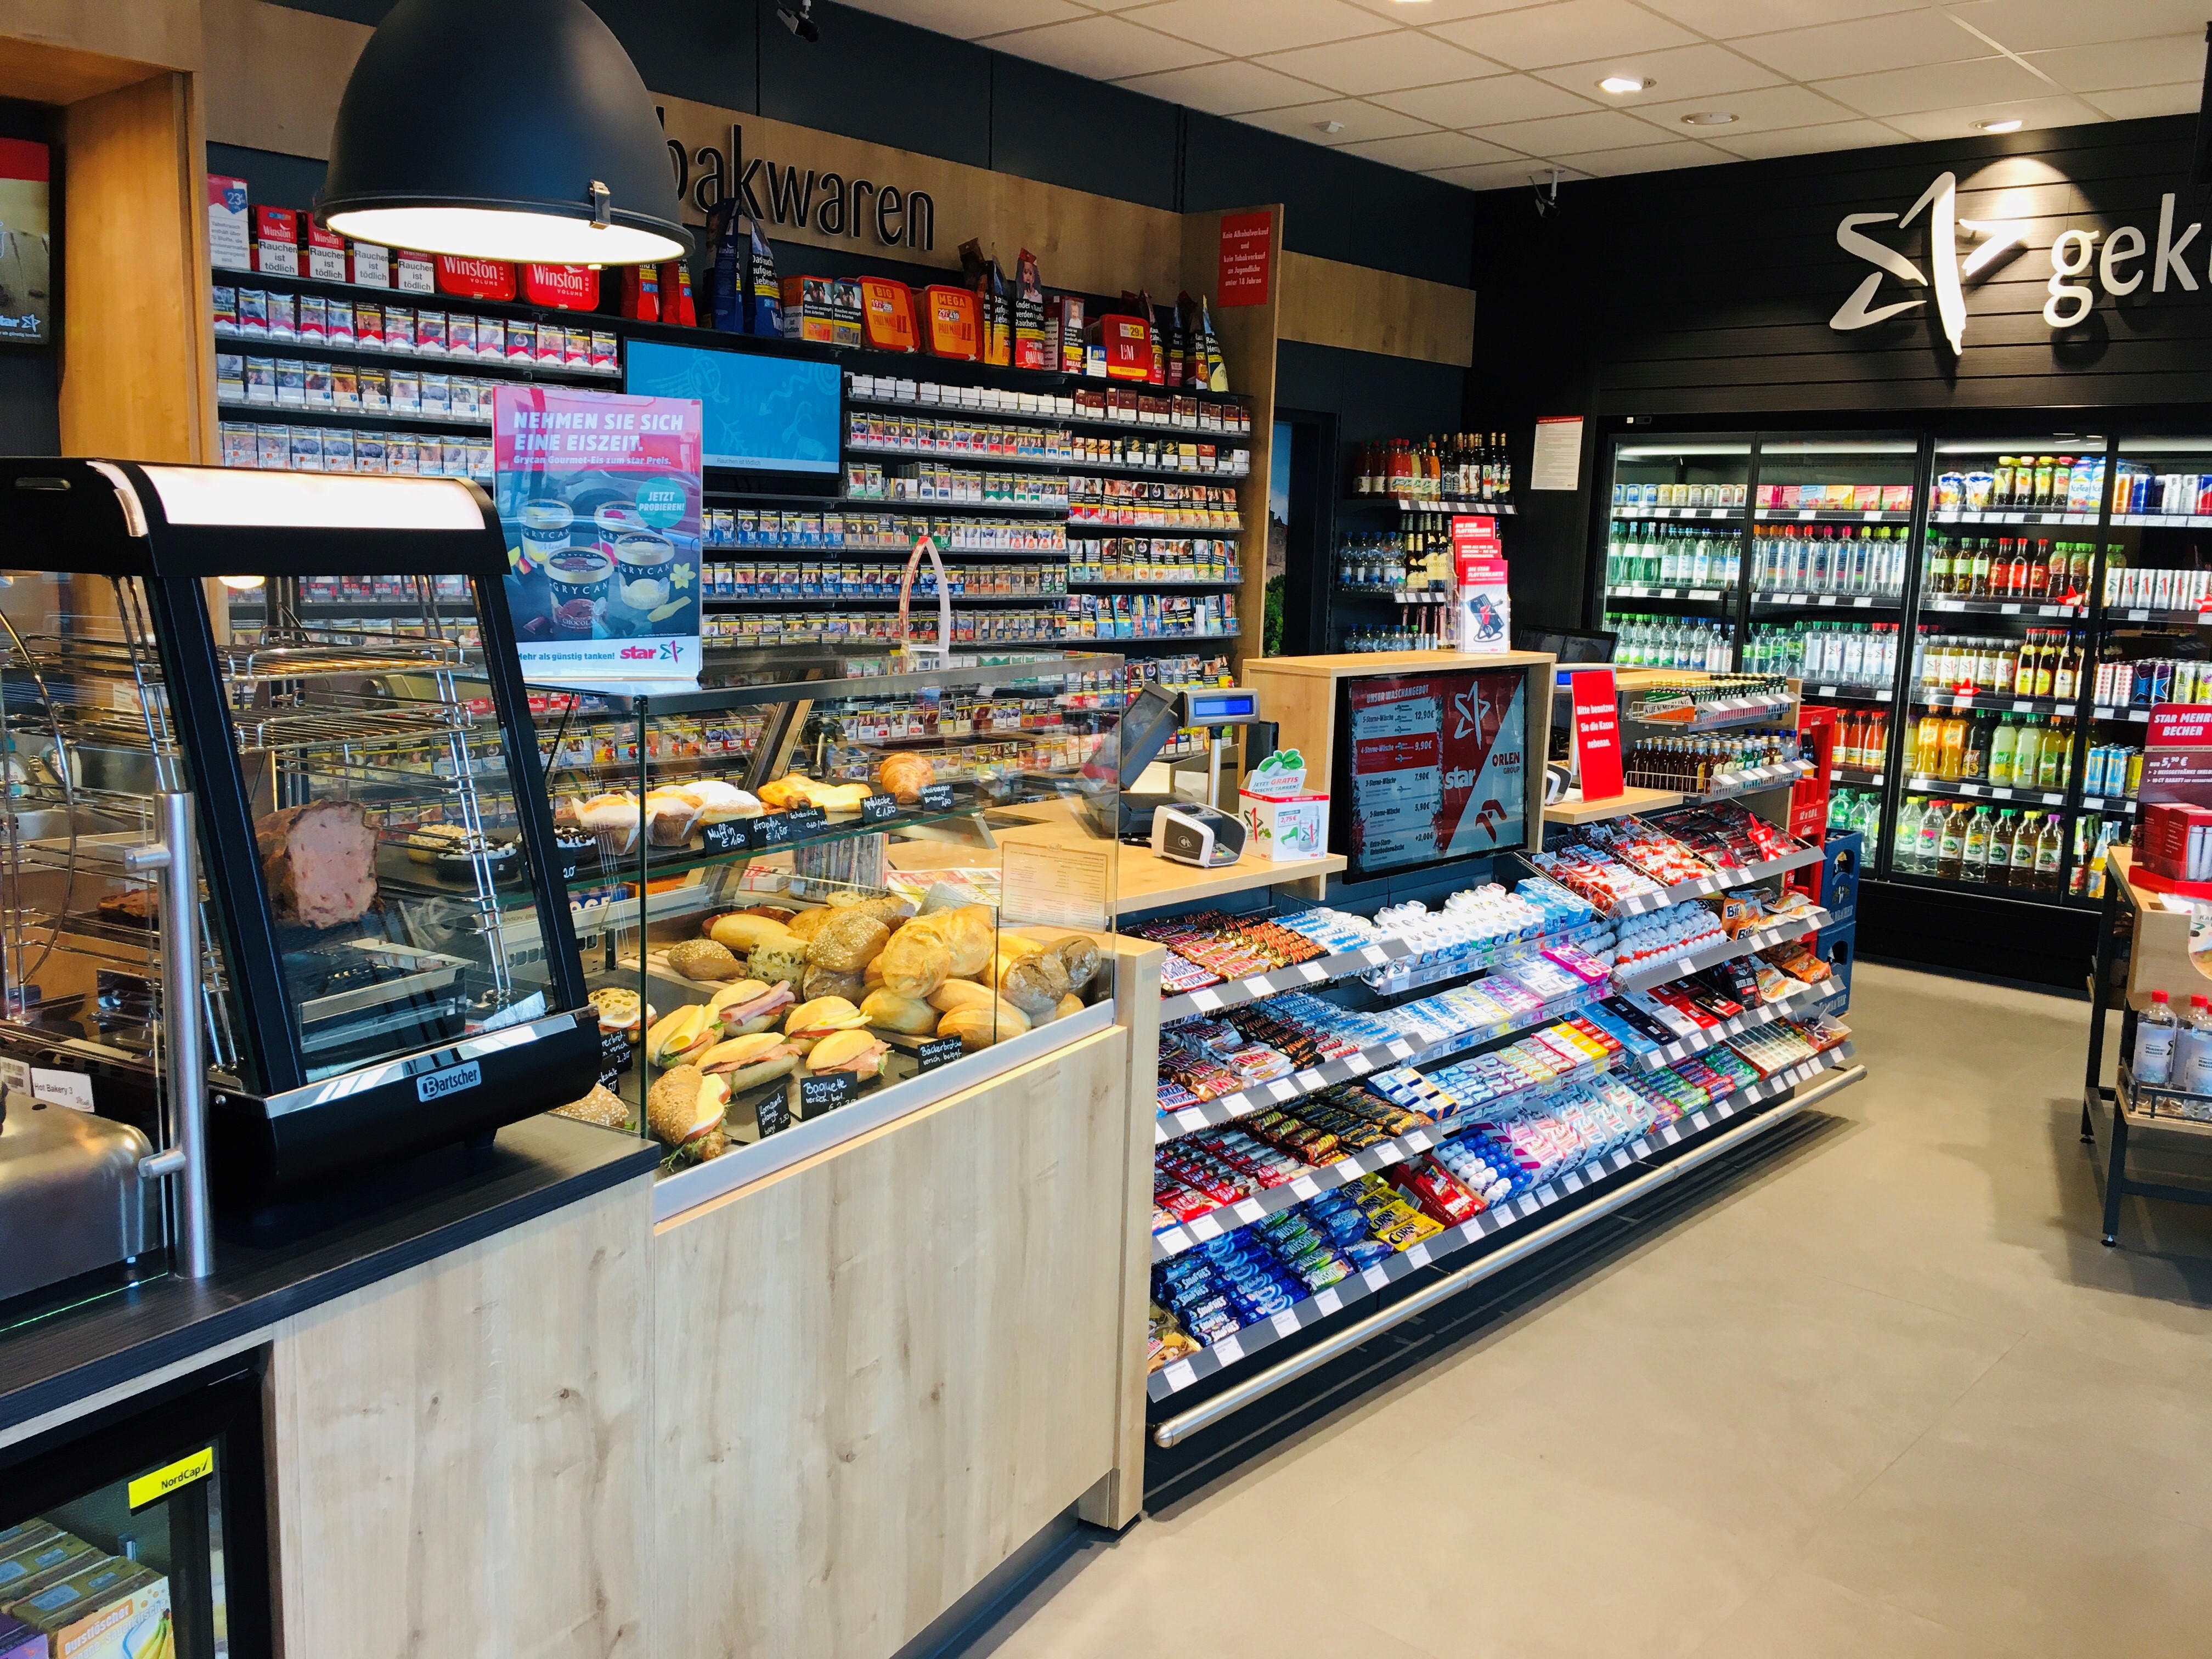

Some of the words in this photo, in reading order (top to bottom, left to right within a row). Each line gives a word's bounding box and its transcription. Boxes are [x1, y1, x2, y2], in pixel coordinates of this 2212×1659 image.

[263, 225, 290, 238] Winston
[314, 232, 339, 245] Winston
[259, 241, 297, 253] Rauchen
[310, 247, 345, 259] Rauchen
[275, 253, 285, 262] ist
[354, 250, 389, 262] Rauchen
[2042, 193, 2212, 328] gek
[265, 263, 295, 273] tödlich
[324, 259, 334, 268] ist
[399, 261, 433, 272] Rauchen
[443, 256, 498, 280] Winston
[315, 268, 342, 279] tödlich
[360, 270, 387, 281] tödlich
[532, 264, 583, 290] Winston
[404, 281, 431, 291] tödlich
[470, 278, 498, 286] VOLUME
[557, 289, 583, 297] VOLUME
[876, 287, 893, 298] BIG
[938, 294, 966, 307] MEGA
[514, 411, 598, 430] NEHMEN
[605, 413, 635, 430] SIE
[640, 414, 684, 431] SICH
[514, 434, 561, 451] EINE
[567, 435, 644, 452] EISZEIT.
[514, 455, 545, 465] Grycan
[549, 455, 603, 465] Gourmet-Eis
[627, 456, 644, 465] star
[646, 456, 672, 465] Preis.
[716, 457, 738, 465] Rauchen
[648, 492, 675, 501] JETZT
[639, 503, 685, 511] PROBIEREN!
[620, 562, 670, 575] GRYCAN
[553, 581, 608, 595] GRYCAN
[552, 652, 582, 662] günstig
[620, 645, 657, 659] star
[1366, 692, 1385, 704] UNSER
[1576, 706, 1590, 715] Bitte
[1590, 704, 1615, 713] benutzen
[2154, 714, 2178, 723] STAR
[2180, 713, 2212, 723] MEHR
[1580, 723, 1589, 732] Sie
[1590, 721, 1599, 731] die
[1599, 720, 1614, 730] Kasse
[2162, 726, 2204, 736] BECHER
[1587, 738, 1611, 749] nebenan.
[1492, 752, 1520, 767] ORLEN
[1271, 776, 1299, 786] GRATIS
[1444, 766, 1476, 790] star
[753, 818, 781, 832] Krapfen
[707, 823, 735, 841] Muffin
[1290, 944, 1325, 964] Mars
[35, 1082, 46, 1092] Hot
[47, 1084, 68, 1096] Bakery
[422, 1069, 477, 1097] Bartscher
[803, 1078, 848, 1096] Baguette
[1316, 1133, 1338, 1153] LION
[1370, 1209, 1397, 1233] CORNY
[1389, 1221, 1417, 1245] CORNY
[1403, 1233, 1414, 1242] BIG
[1197, 1295, 1227, 1318] SMARTIES
[1211, 1319, 1240, 1342] SMARTIES
[161, 1465, 201, 1491] NordCap
